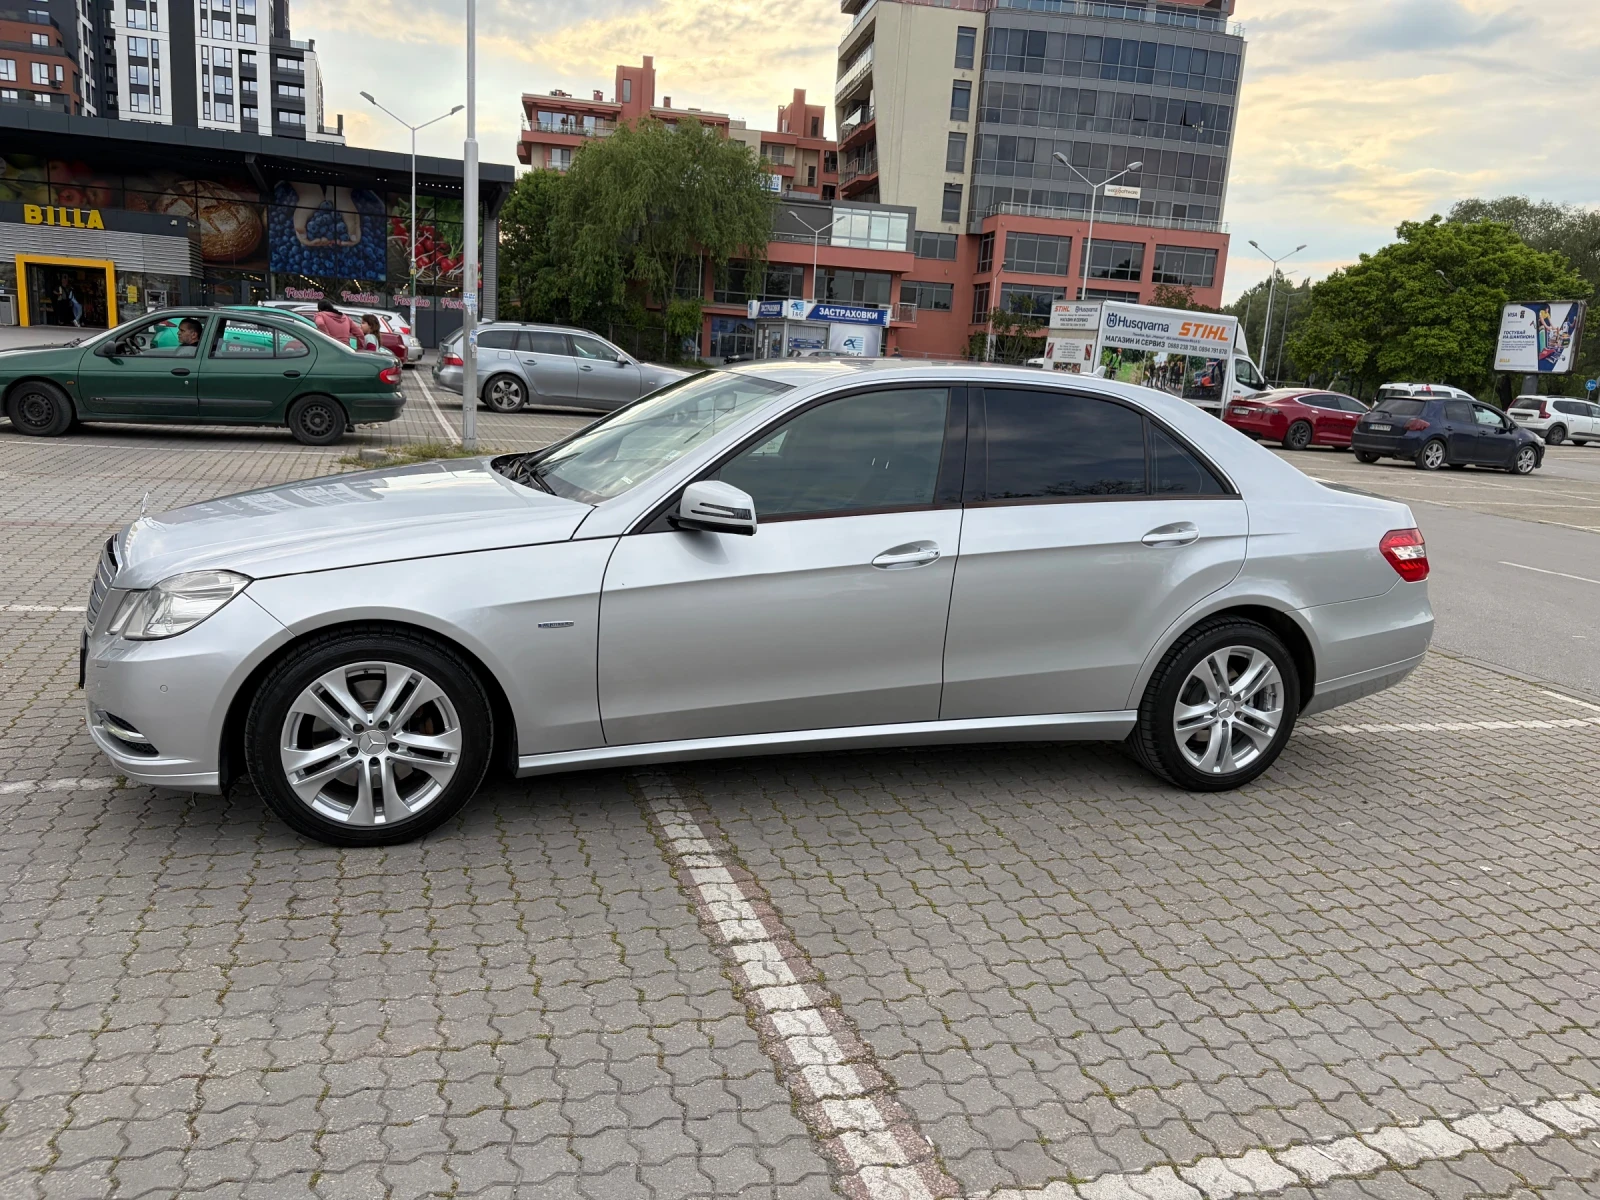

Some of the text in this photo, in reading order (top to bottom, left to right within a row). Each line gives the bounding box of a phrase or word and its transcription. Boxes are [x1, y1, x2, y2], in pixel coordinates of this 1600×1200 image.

[23, 203, 105, 230] BILLA
[285, 286, 324, 300] Festiko
[341, 290, 380, 304] Festiko
[393, 294, 430, 307] Fesiko
[818, 307, 878, 320] ЗАСТРАХОВКИ
[1118, 315, 1170, 333] Husqvarna
[1178, 321, 1228, 342] STIHL
[1104, 334, 1134, 345] МАГАЗИН
[1141, 339, 1165, 348] СЕРВИЗ
